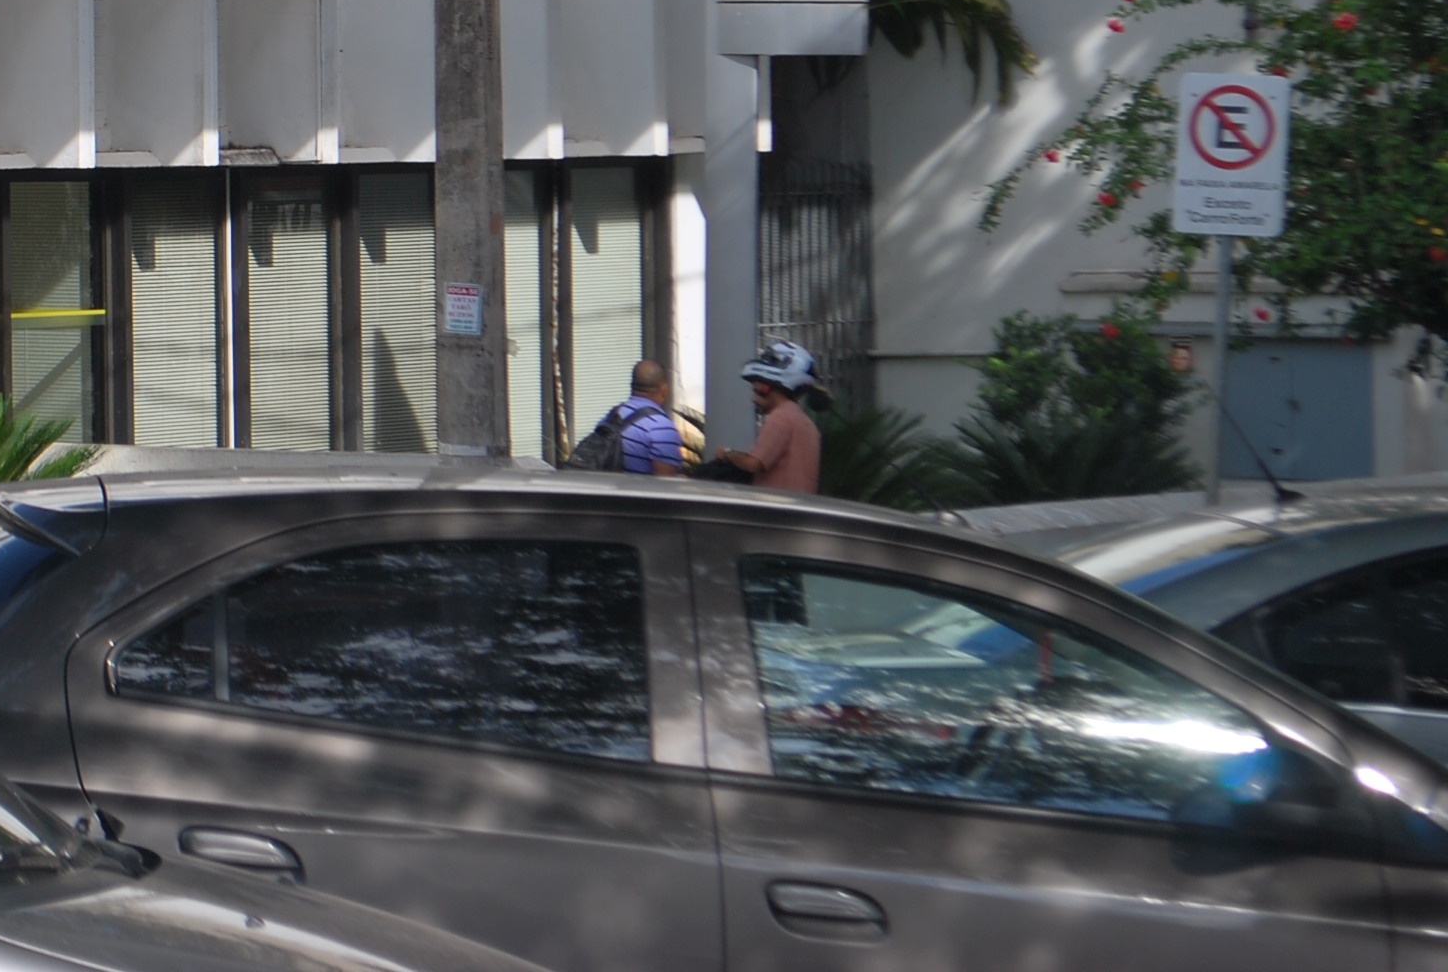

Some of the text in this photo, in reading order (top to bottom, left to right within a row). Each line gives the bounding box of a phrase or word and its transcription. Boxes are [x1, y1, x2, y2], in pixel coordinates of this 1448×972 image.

[1215, 106, 1250, 149] E
[1229, 180, 1280, 191] AMARELA
[1203, 196, 1253, 210] Exceto
